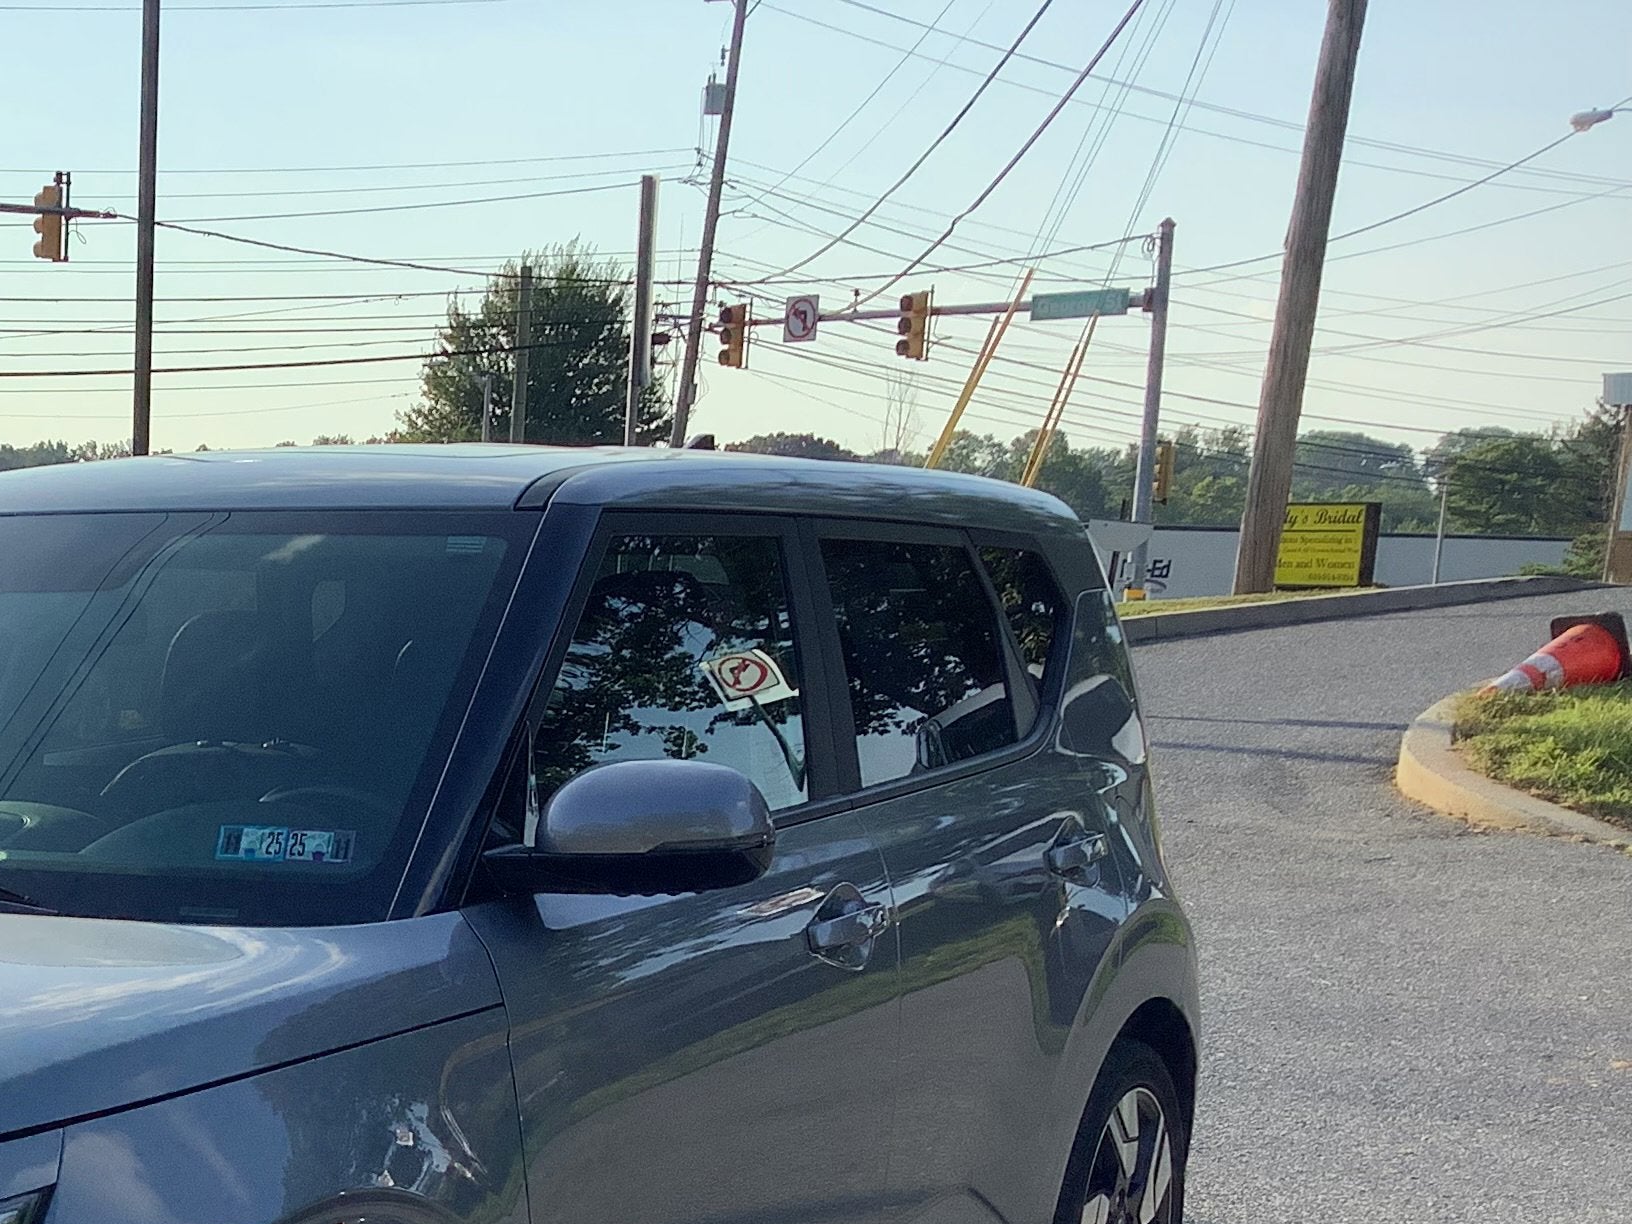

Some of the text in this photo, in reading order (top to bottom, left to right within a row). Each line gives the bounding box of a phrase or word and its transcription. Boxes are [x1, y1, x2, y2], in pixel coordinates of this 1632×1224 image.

[1314, 508, 1365, 524] Bridal
[265, 831, 284, 855] 25
[289, 832, 308, 857] 25
